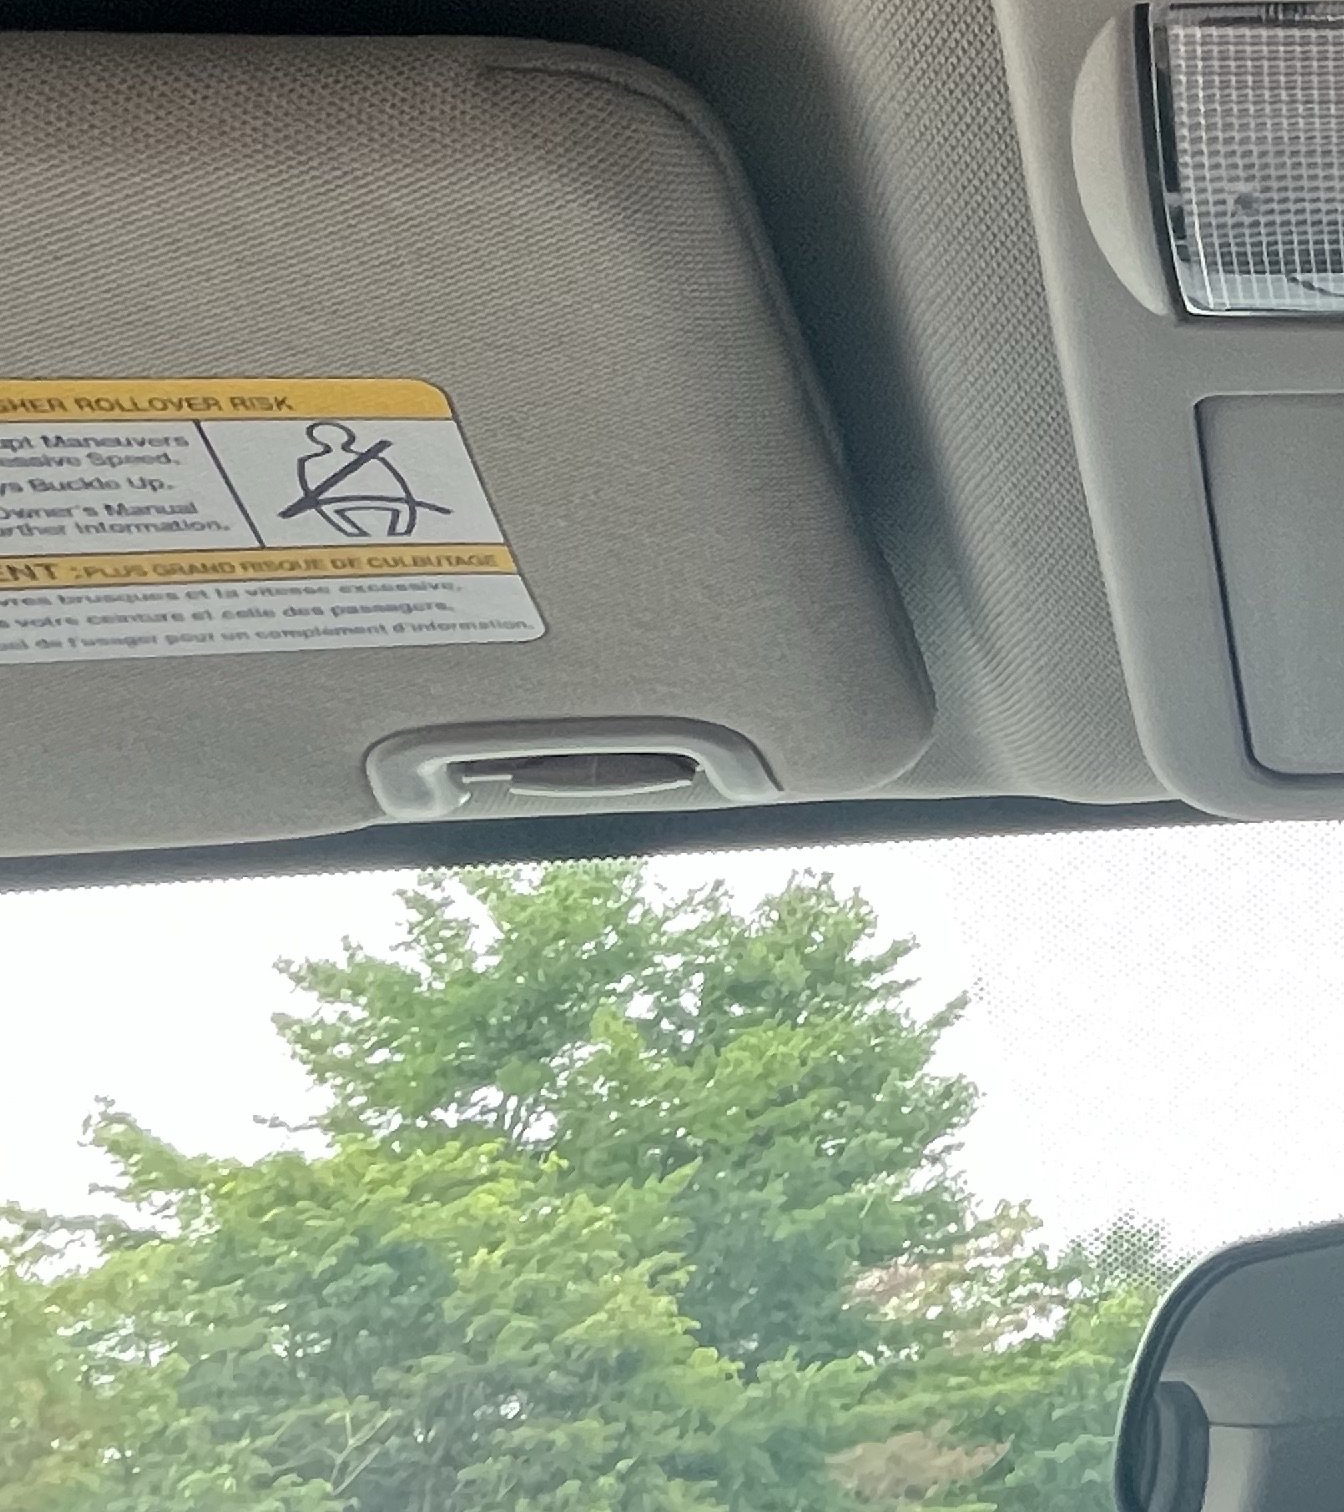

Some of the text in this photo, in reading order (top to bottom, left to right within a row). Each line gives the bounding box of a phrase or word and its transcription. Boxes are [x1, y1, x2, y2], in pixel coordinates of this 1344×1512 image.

[74, 396, 223, 412] ROLLOVER
[230, 395, 295, 412] RISK
[40, 434, 190, 448] Maneuvers
[27, 476, 122, 493] Buckle
[126, 475, 174, 493] Up.
[104, 501, 199, 517] Manual
[153, 560, 236, 576] GRAND
[366, 554, 499, 569] CULBUTAGE
